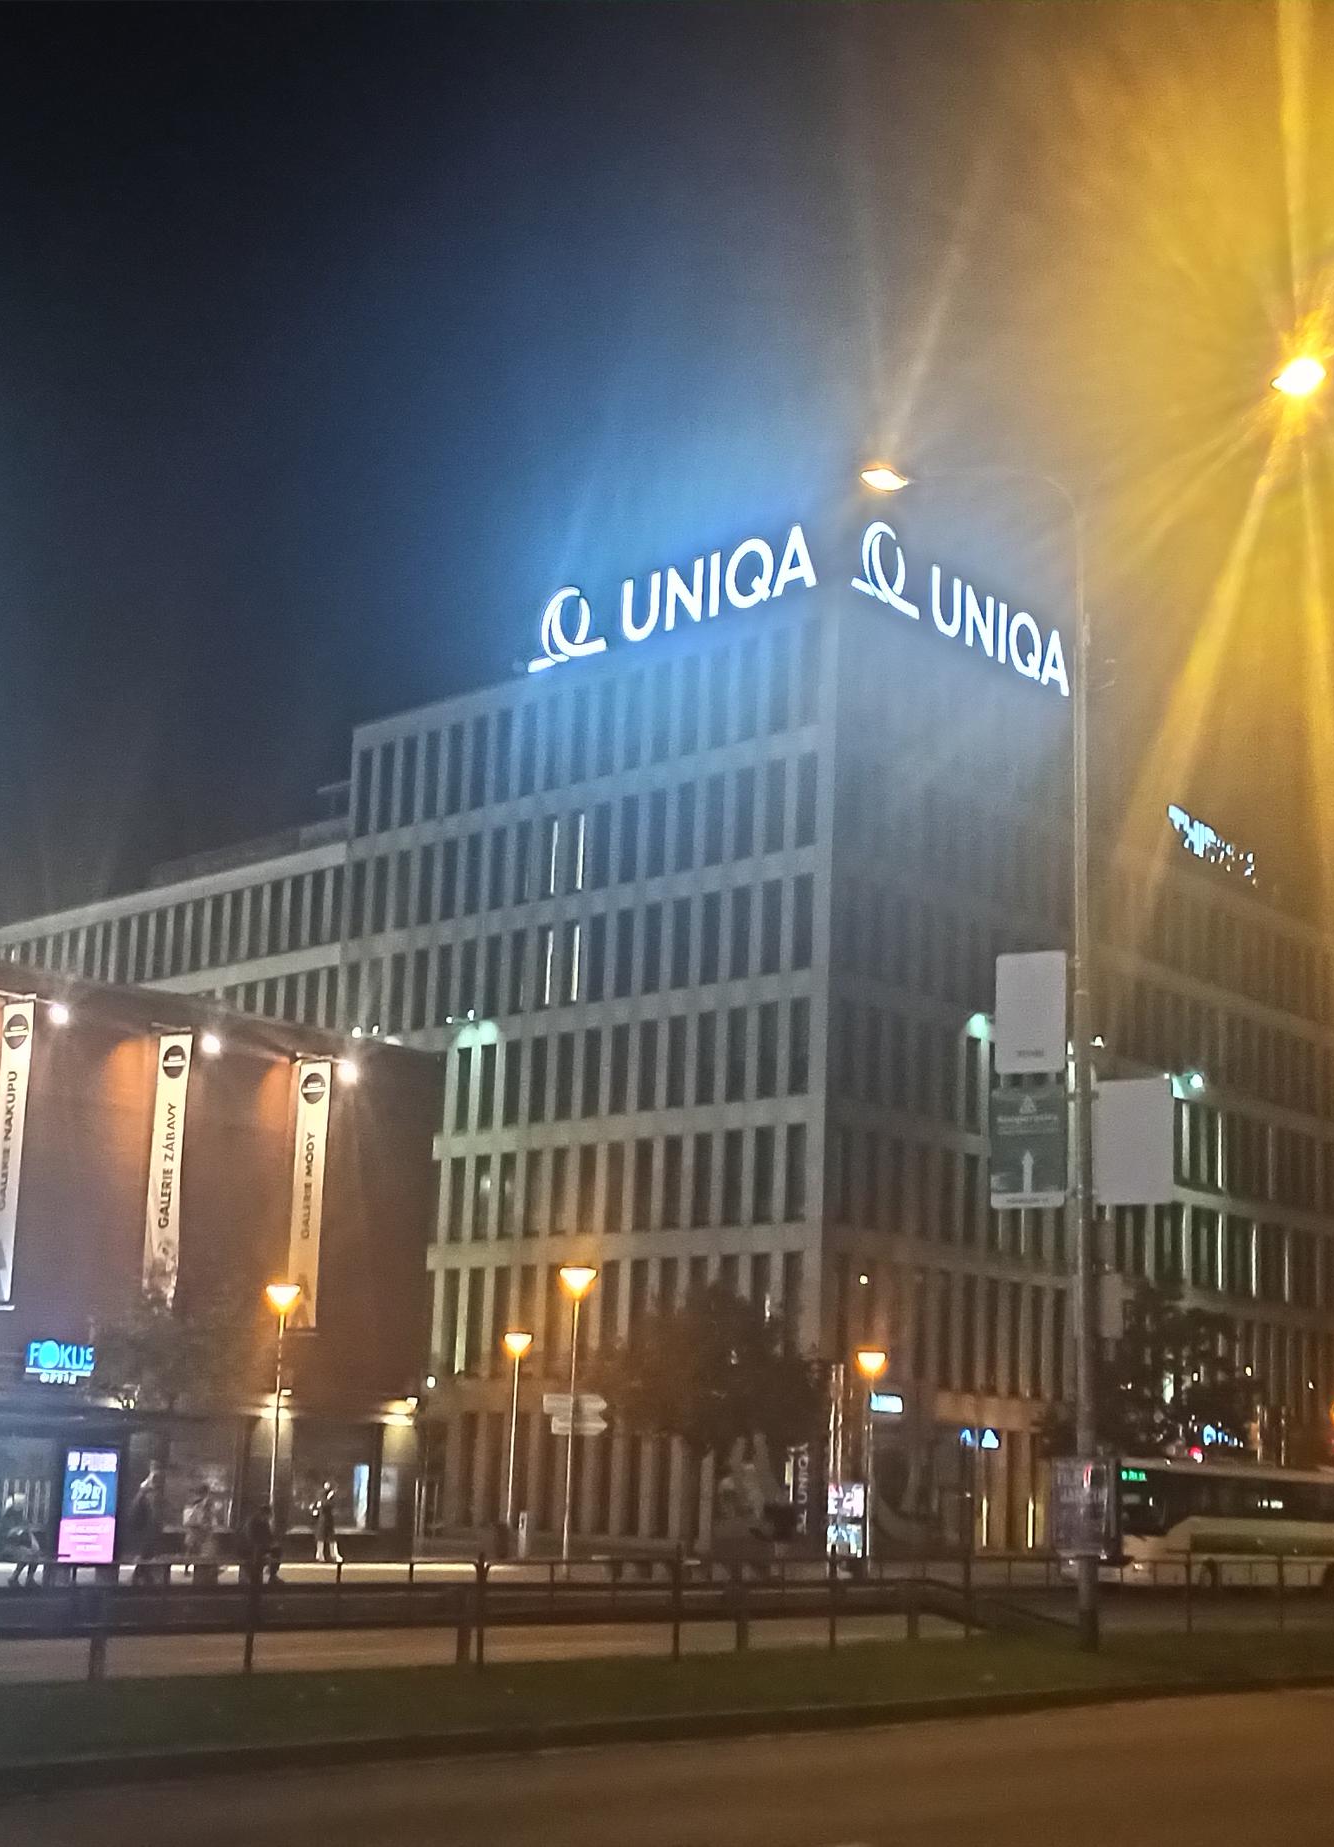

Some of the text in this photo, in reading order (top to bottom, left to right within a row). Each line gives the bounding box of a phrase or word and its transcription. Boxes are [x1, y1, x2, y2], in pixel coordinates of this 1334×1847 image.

[620, 523, 817, 641] UNIQA
[931, 564, 1069, 697] UNIQA
[158, 1103, 177, 1230] GALERIE ZÁBAVY
[300, 1182, 312, 1240] GALERIE
[29, 1340, 94, 1370] FOKUS
